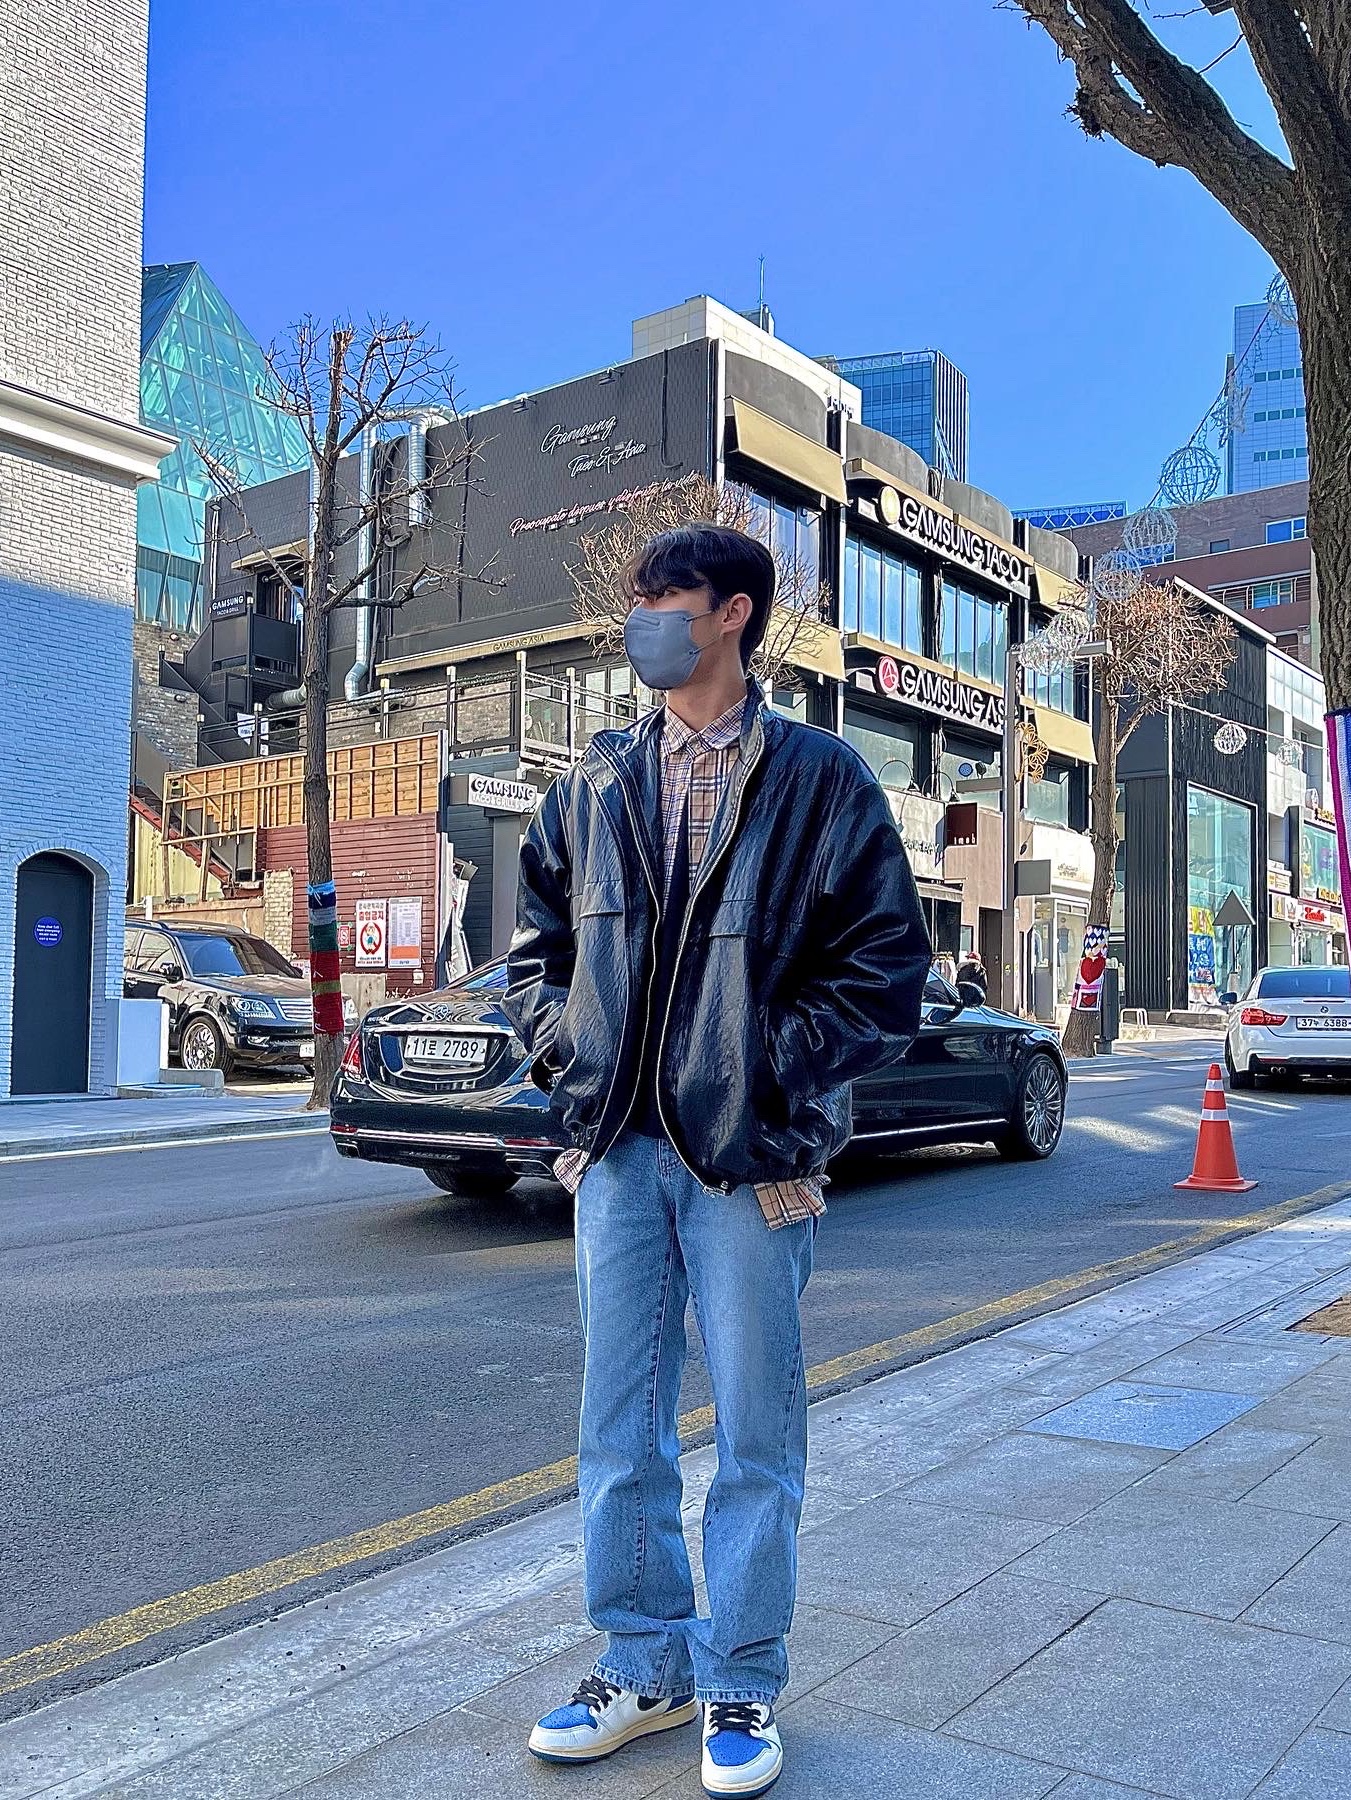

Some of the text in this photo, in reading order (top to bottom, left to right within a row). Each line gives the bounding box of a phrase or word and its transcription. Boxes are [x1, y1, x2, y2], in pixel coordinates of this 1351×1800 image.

[541, 416, 617, 455] Gamsung
[568, 439, 647, 477] Taco & Asia
[903, 498, 1021, 581] GAMSUNG TACO
[212, 595, 244, 610] GAMSUNG
[493, 634, 545, 651] GAMSUNG ASIA
[902, 665, 986, 718] GAMSUNG
[471, 777, 534, 801] GAMSUNG
[358, 911, 384, 921] 출입금지
[1323, 1018, 1348, 1027] 6388
[413, 1037, 479, 1059] 11로 2789
